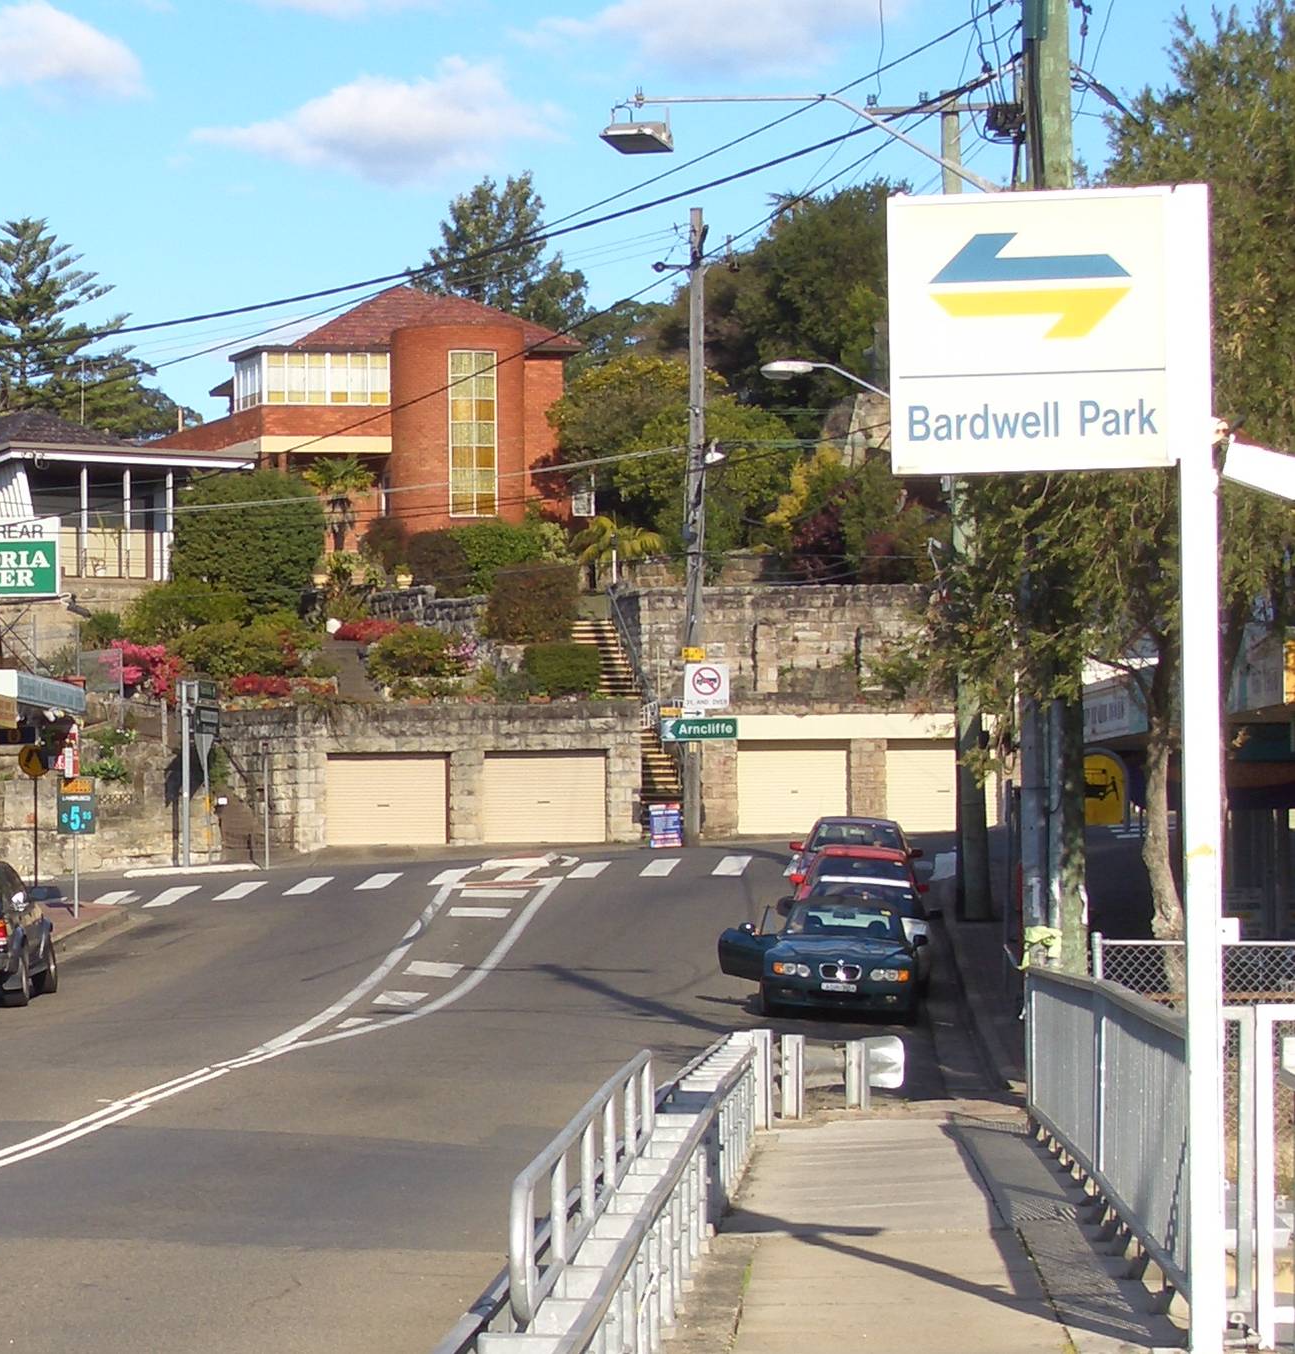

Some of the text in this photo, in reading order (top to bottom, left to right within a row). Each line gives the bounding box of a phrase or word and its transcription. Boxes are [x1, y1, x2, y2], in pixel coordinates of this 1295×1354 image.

[908, 398, 1158, 441] Bardwell Park
[679, 723, 733, 735] Arncliffe
